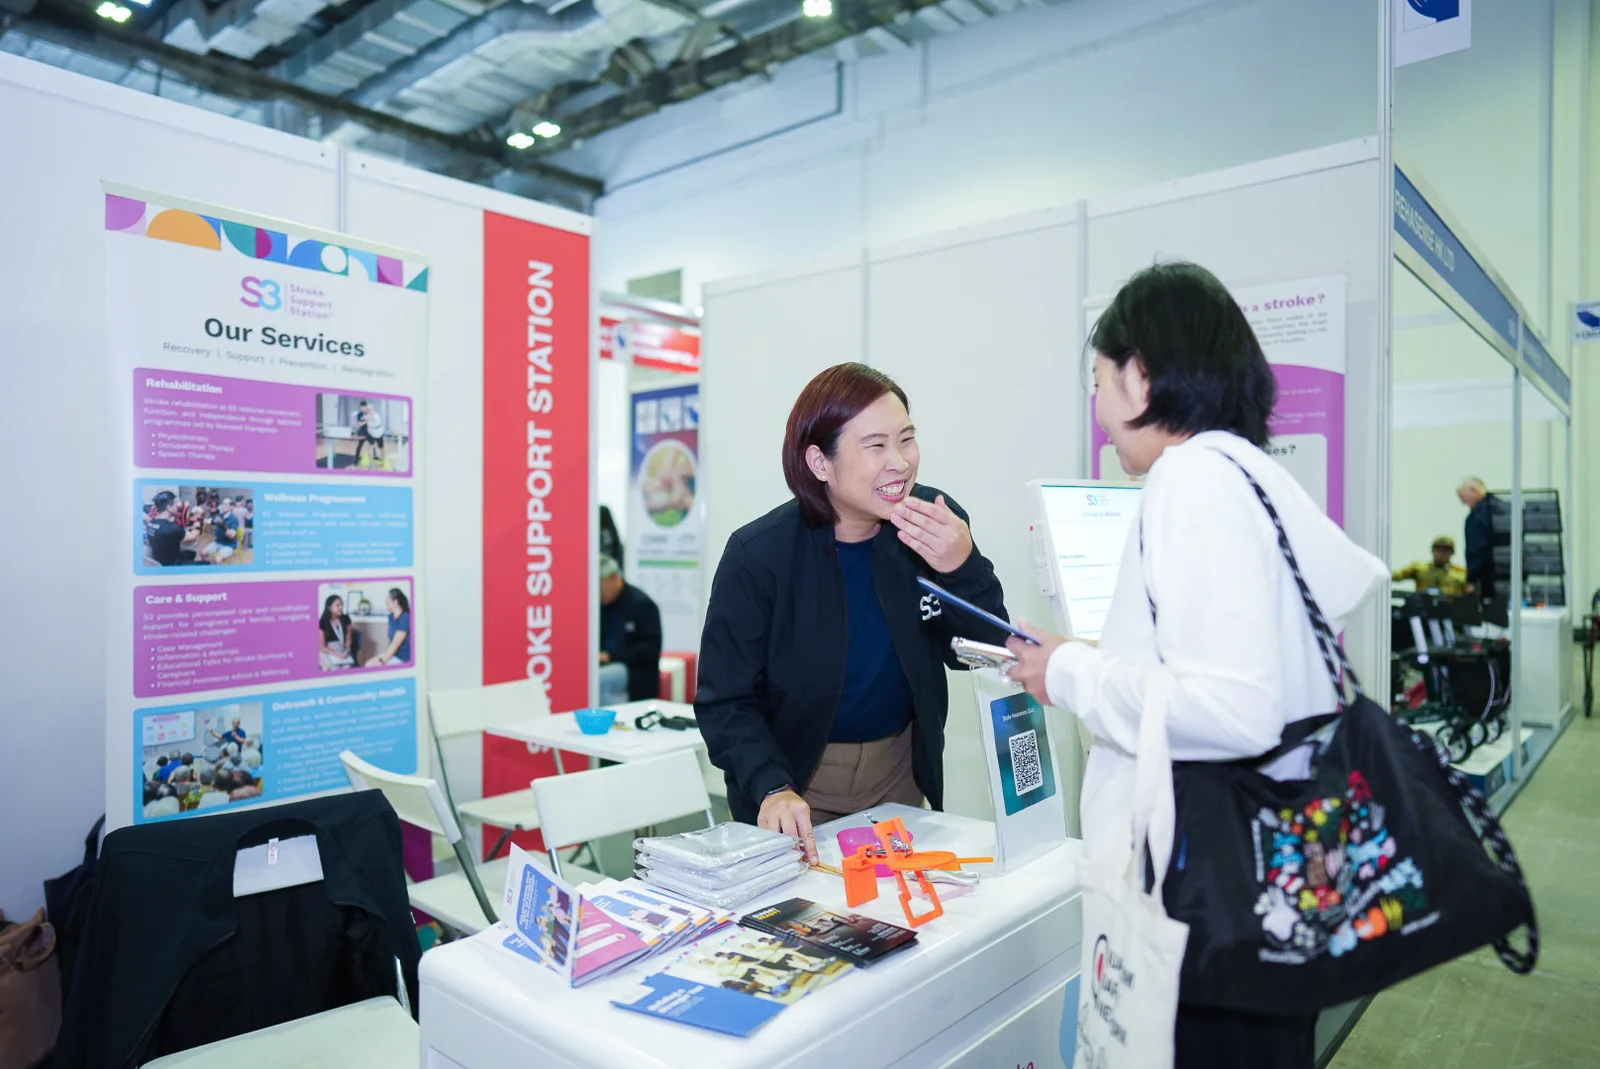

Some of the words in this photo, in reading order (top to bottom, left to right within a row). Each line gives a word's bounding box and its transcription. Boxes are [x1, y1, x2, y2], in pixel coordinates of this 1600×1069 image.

[240, 276, 282, 311] S3
[290, 284, 324, 297] Stroke
[290, 295, 332, 310] Support
[1252, 304, 1260, 312] a
[1264, 293, 1326, 311] stroke?
[204, 318, 252, 342] Our
[261, 327, 365, 357] Services
[527, 260, 553, 414] STATION
[163, 342, 211, 357] Recovery
[226, 351, 265, 364] Support
[279, 358, 329, 370] Prevention
[145, 378, 223, 394] Rehabilitation
[1086, 494, 1098, 506] S3
[527, 420, 553, 597] SUPPORT
[145, 595, 173, 604] Care
[175, 594, 183, 603] &
[185, 592, 228, 604] Support
[920, 593, 942, 620] S3
[157, 612, 190, 621] provides
[143, 622, 174, 632] support
[157, 644, 176, 653] Case
[157, 652, 199, 662] Information
[157, 661, 200, 671] Educational
[157, 670, 196, 680] Caregivers
[157, 680, 190, 689] Financial
[272, 698, 316, 711] Outreach
[318, 697, 325, 706] &
